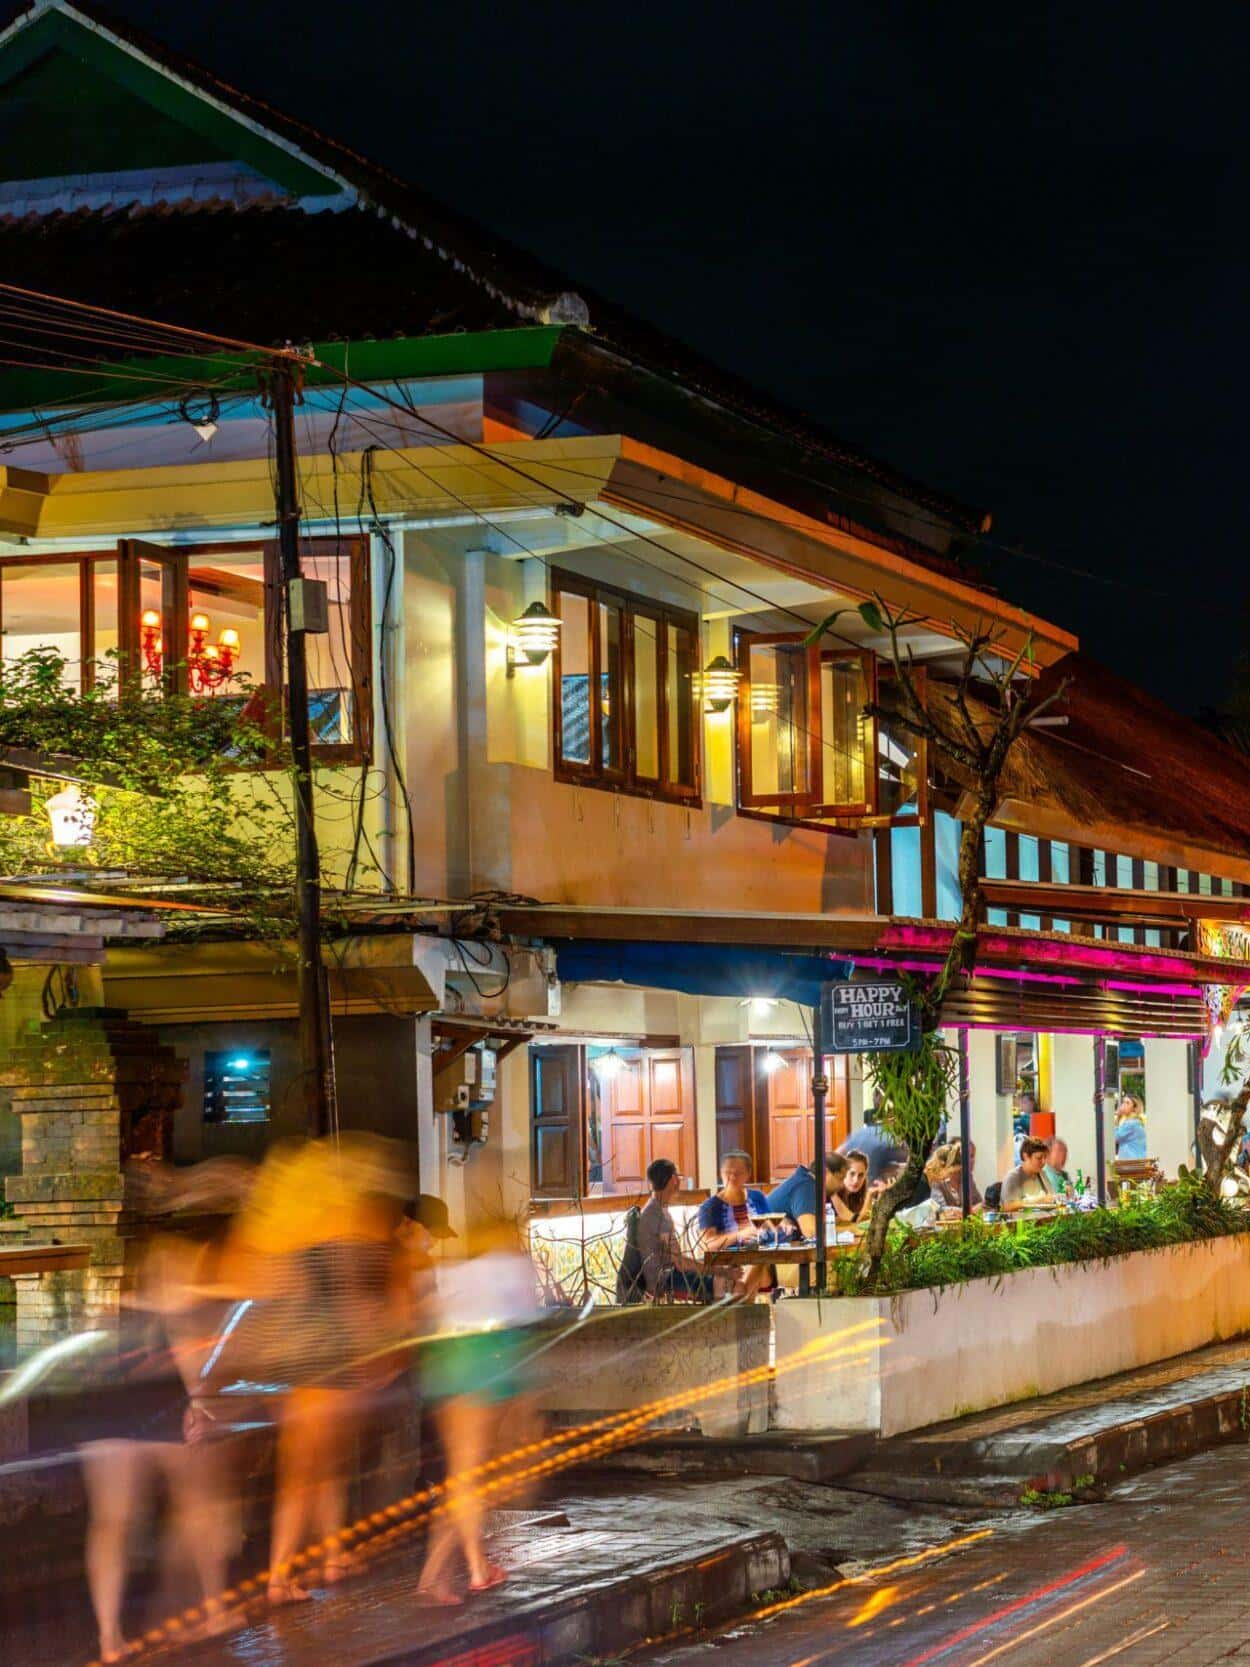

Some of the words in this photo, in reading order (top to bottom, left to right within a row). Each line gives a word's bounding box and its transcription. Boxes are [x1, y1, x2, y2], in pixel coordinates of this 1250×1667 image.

[840, 987, 902, 1003] HAPPY
[851, 1002, 896, 1017] HOUR
[886, 1018, 904, 1026] FREE
